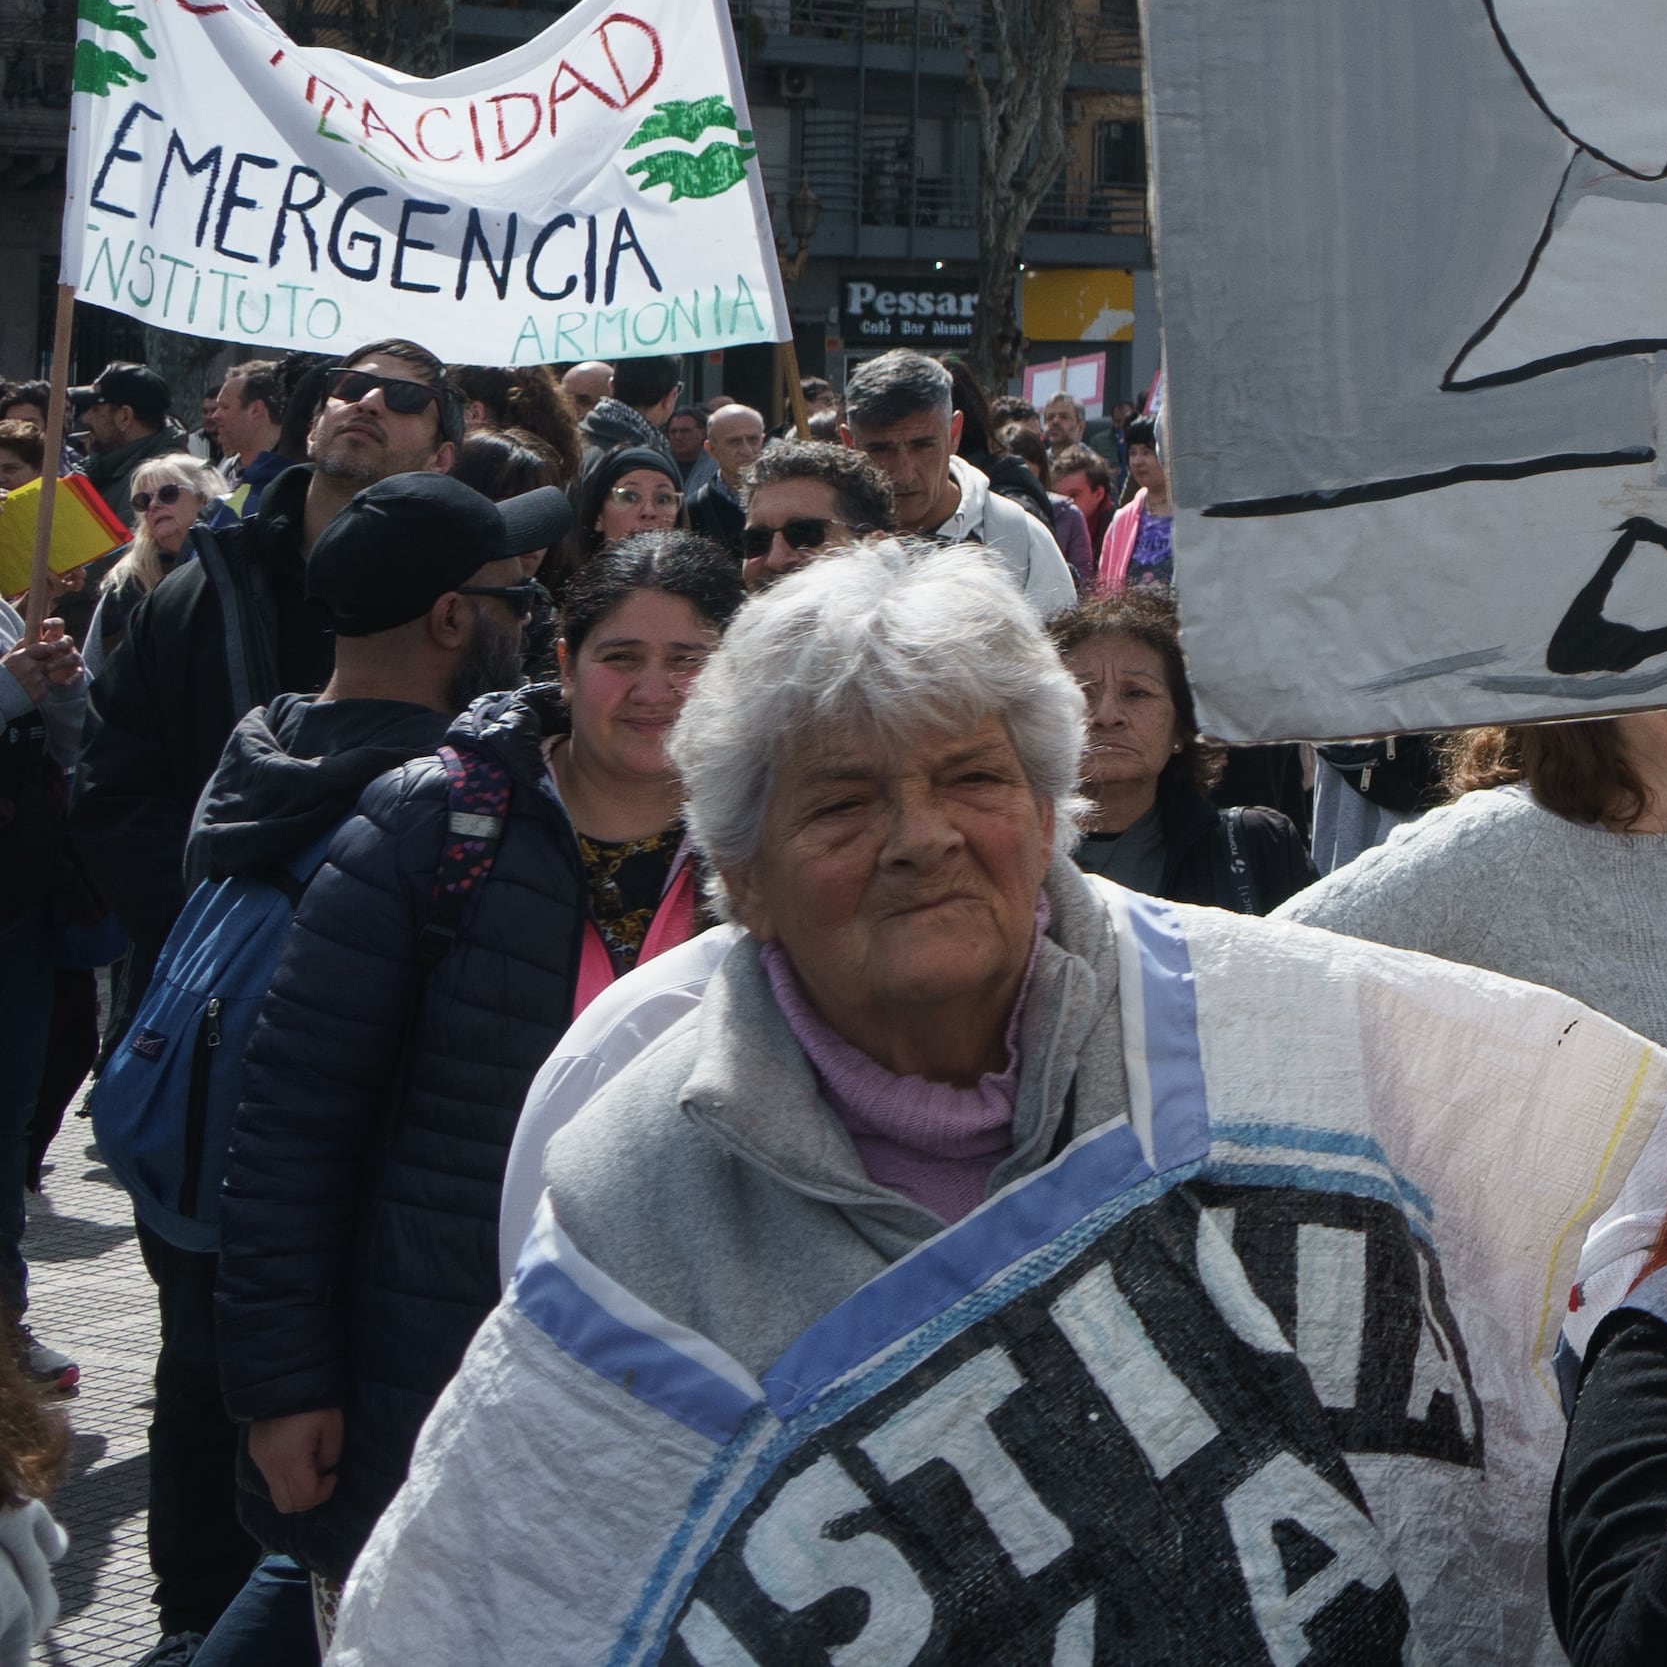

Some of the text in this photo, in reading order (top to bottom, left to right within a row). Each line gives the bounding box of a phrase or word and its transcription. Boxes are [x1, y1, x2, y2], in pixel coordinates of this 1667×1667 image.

[90, 101, 662, 305] EMERGENCIA
[510, 273, 767, 364] ARMONIA
[861, 318, 892, 335] Café
[901, 320, 925, 335] Bar
